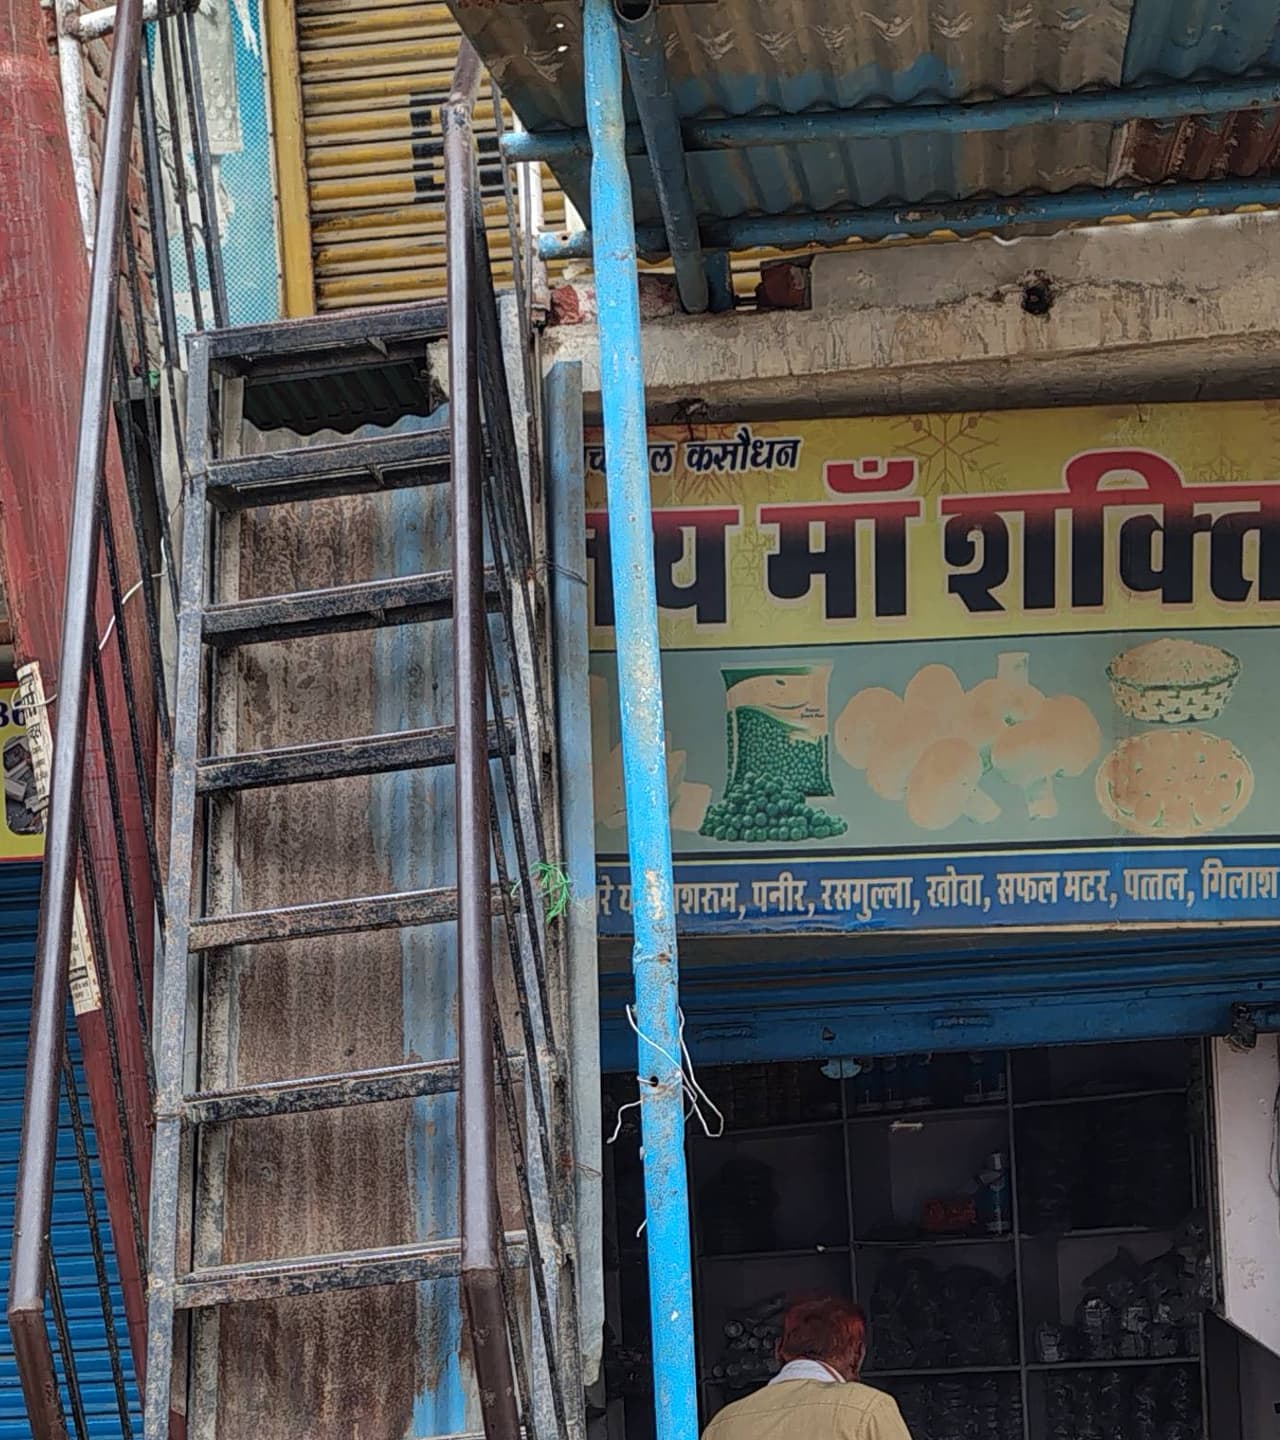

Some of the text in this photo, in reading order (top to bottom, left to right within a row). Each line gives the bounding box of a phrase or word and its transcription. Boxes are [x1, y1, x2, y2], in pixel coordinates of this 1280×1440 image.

[686, 427, 802, 471] कसौधन
[761, 457, 920, 618] माँ
[751, 871, 815, 918] पनीर,
[821, 876, 920, 921] रसगुल्ला,
[926, 866, 991, 913] खोवा,
[998, 871, 1060, 904] सफल
[1063, 867, 1118, 910] मटर,
[1201, 857, 1277, 900] गिलाश
